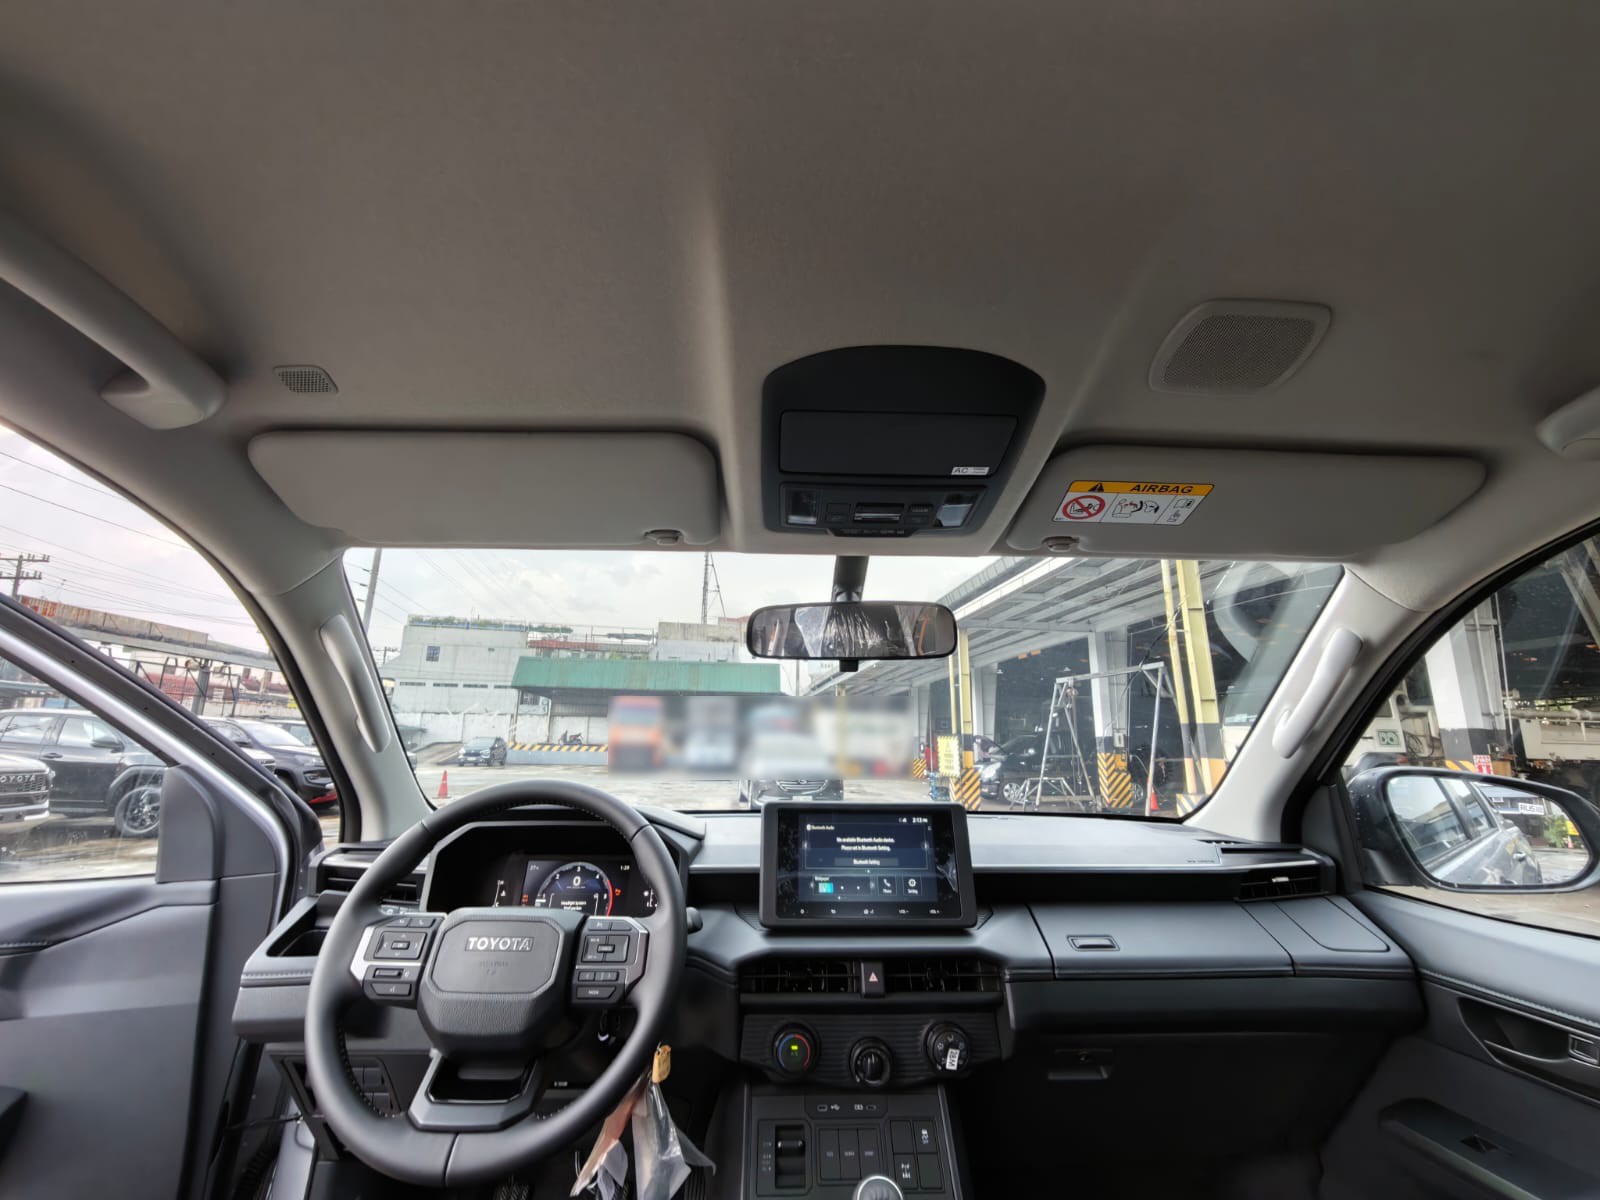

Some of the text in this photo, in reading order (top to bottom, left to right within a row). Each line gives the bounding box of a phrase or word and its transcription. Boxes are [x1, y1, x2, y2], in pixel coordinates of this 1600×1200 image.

[1129, 483, 1194, 494] AIRBAG
[0, 775, 35, 783] OYOTA
[572, 876, 581, 886] 0
[468, 937, 531, 951] TOYOTA
